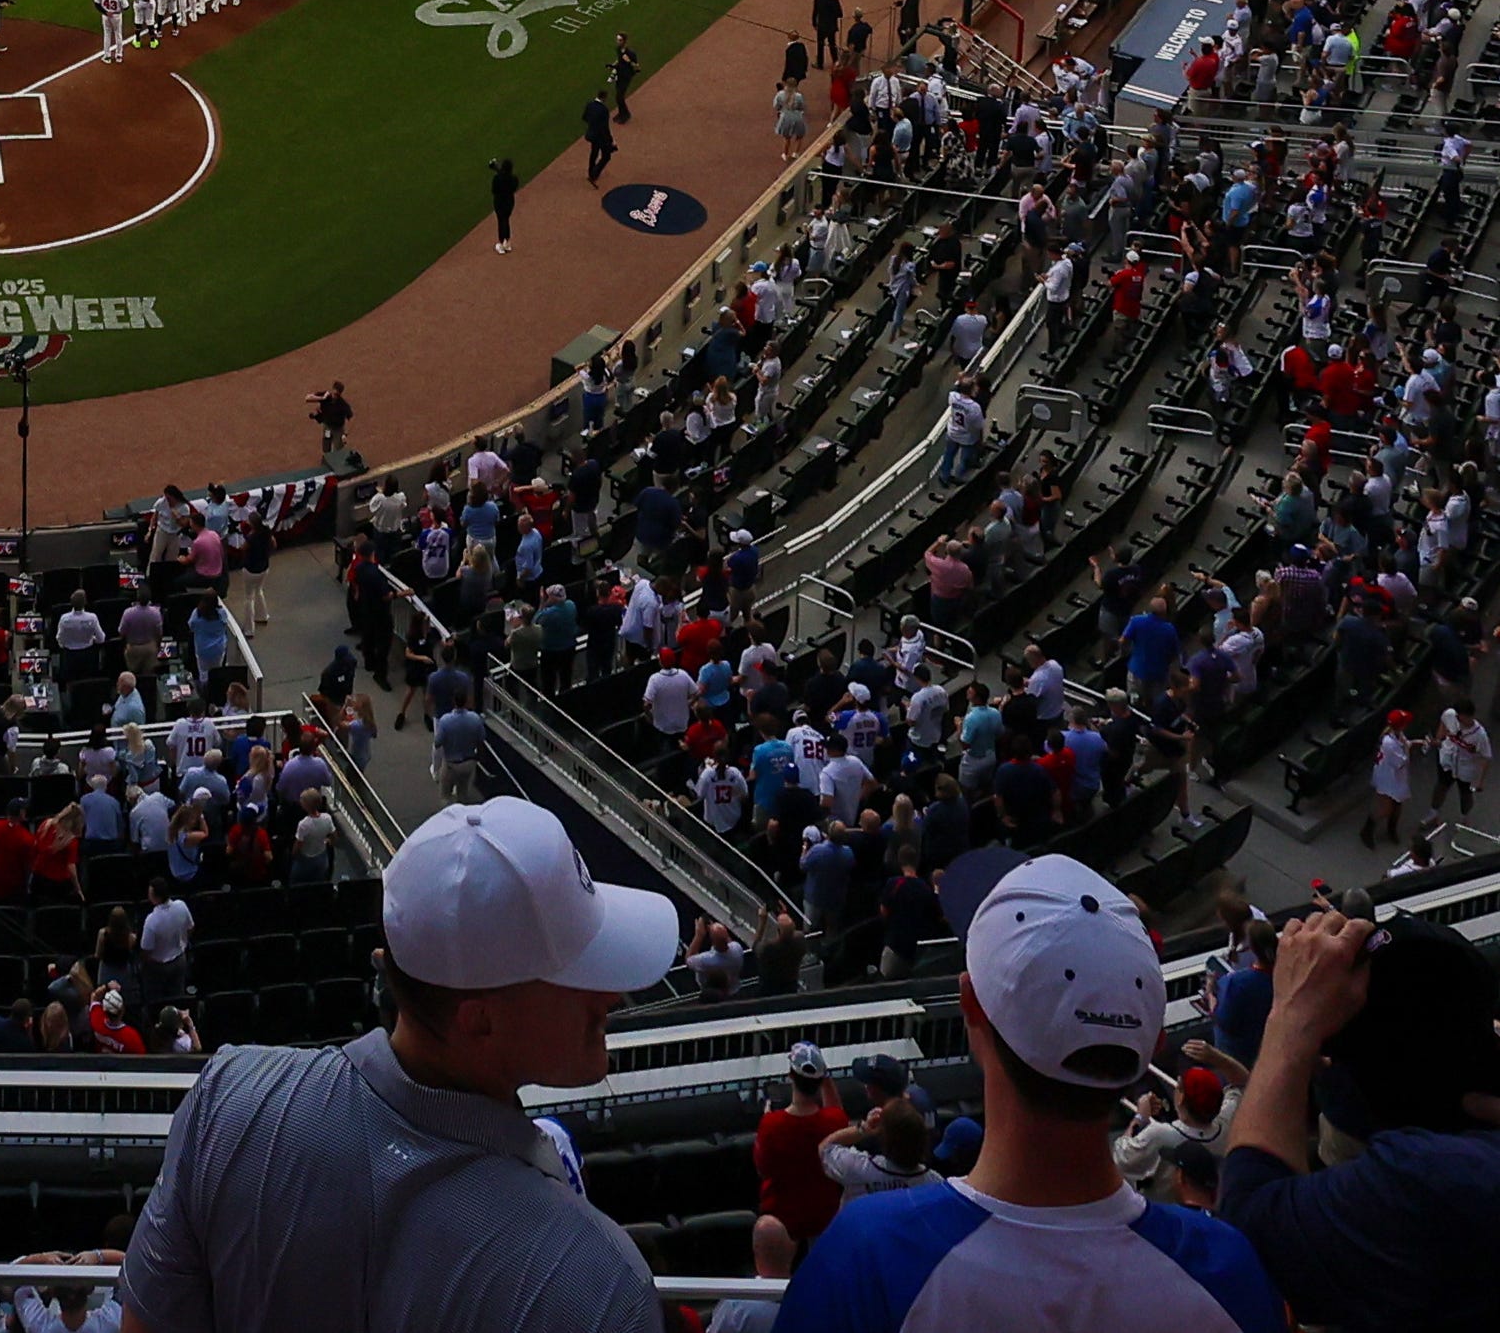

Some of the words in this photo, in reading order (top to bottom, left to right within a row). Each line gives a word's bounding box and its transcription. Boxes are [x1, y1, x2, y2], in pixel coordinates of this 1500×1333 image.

[1154, 18, 1199, 62] WELCOME
[1188, 8, 1208, 27] TO
[25, 293, 165, 332] WEEK
[955, 412, 965, 426] 3
[186, 737, 206, 757] 10
